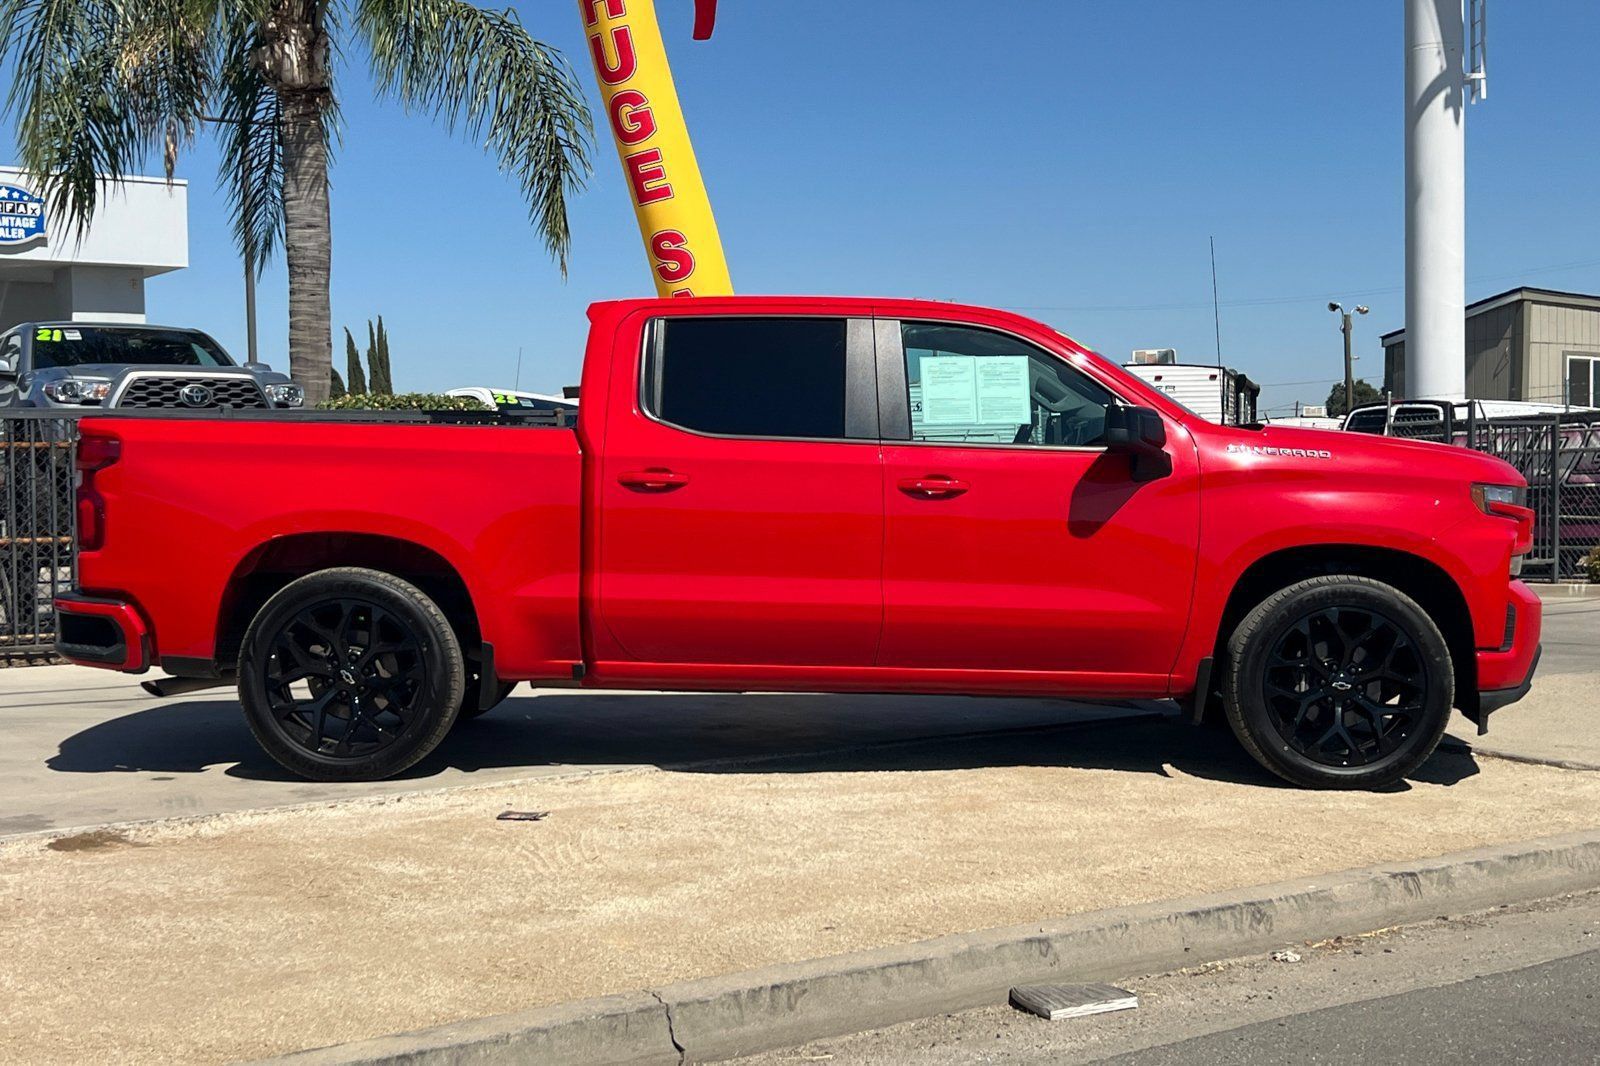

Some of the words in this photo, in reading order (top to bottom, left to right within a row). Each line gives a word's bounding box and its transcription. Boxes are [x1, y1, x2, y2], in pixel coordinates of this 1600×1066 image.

[0, 202, 38, 216] FAX
[0, 216, 38, 228] NTAGE
[650, 229, 696, 297] S
[36, 328, 62, 342] 21
[1227, 443, 1331, 459] SILVERADO
